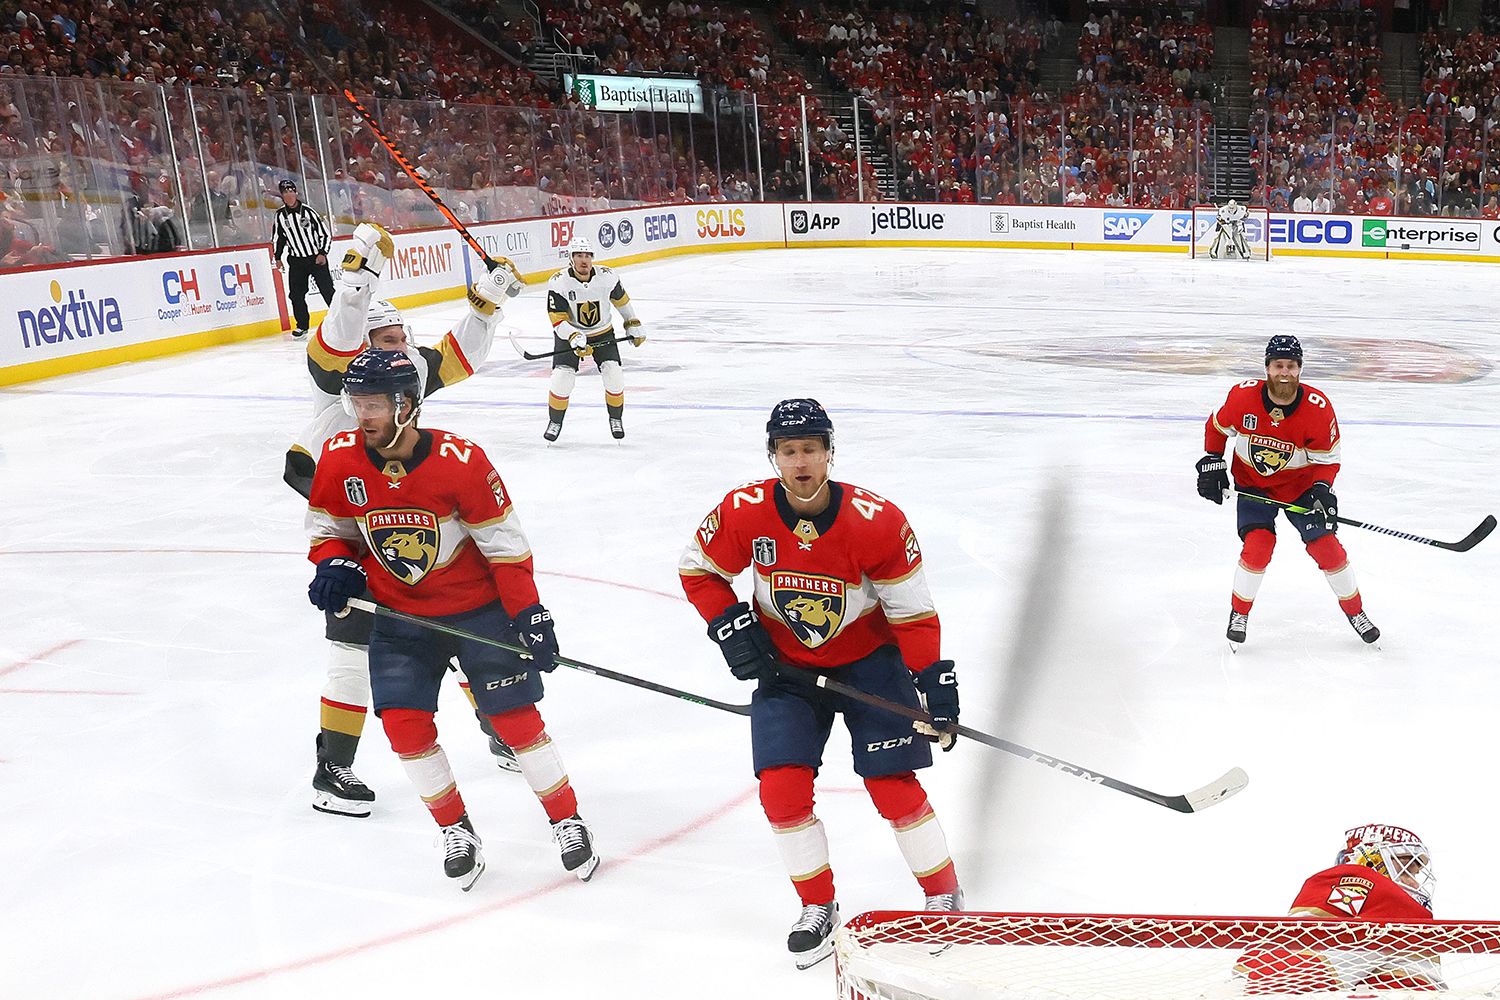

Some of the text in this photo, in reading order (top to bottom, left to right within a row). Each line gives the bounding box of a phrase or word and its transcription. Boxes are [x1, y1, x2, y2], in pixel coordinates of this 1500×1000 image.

[600, 85, 695, 106] Baptist Health
[645, 213, 677, 242] GEICO
[696, 208, 746, 238] SOLIS
[871, 206, 945, 235] jetBlue
[1012, 218, 1076, 231] Baptist Health
[1104, 216, 1142, 236] SAP
[1172, 217, 1210, 237] SAP
[551, 221, 575, 248] DEX
[1244, 218, 1353, 244] GEICO
[1369, 225, 1478, 245] enterprise
[507, 232, 529, 251] CITY
[389, 243, 452, 281] AMERANT
[157, 306, 182, 322] Cooper
[191, 302, 212, 316] Hunter
[216, 299, 238, 313] Cooper
[246, 295, 265, 307] Hunter
[17, 288, 123, 349] nextiva
[1307, 392, 1327, 409] 9
[328, 432, 357, 452] 3
[1253, 437, 1291, 451] PANTHERS
[371, 511, 431, 527] PANTHERS
[777, 575, 839, 594] PANTHERS
[485, 671, 529, 691] CCM
[866, 735, 914, 753] CCM
[1026, 752, 1106, 786] CCM
[1343, 824, 1422, 844] PANTHERS
